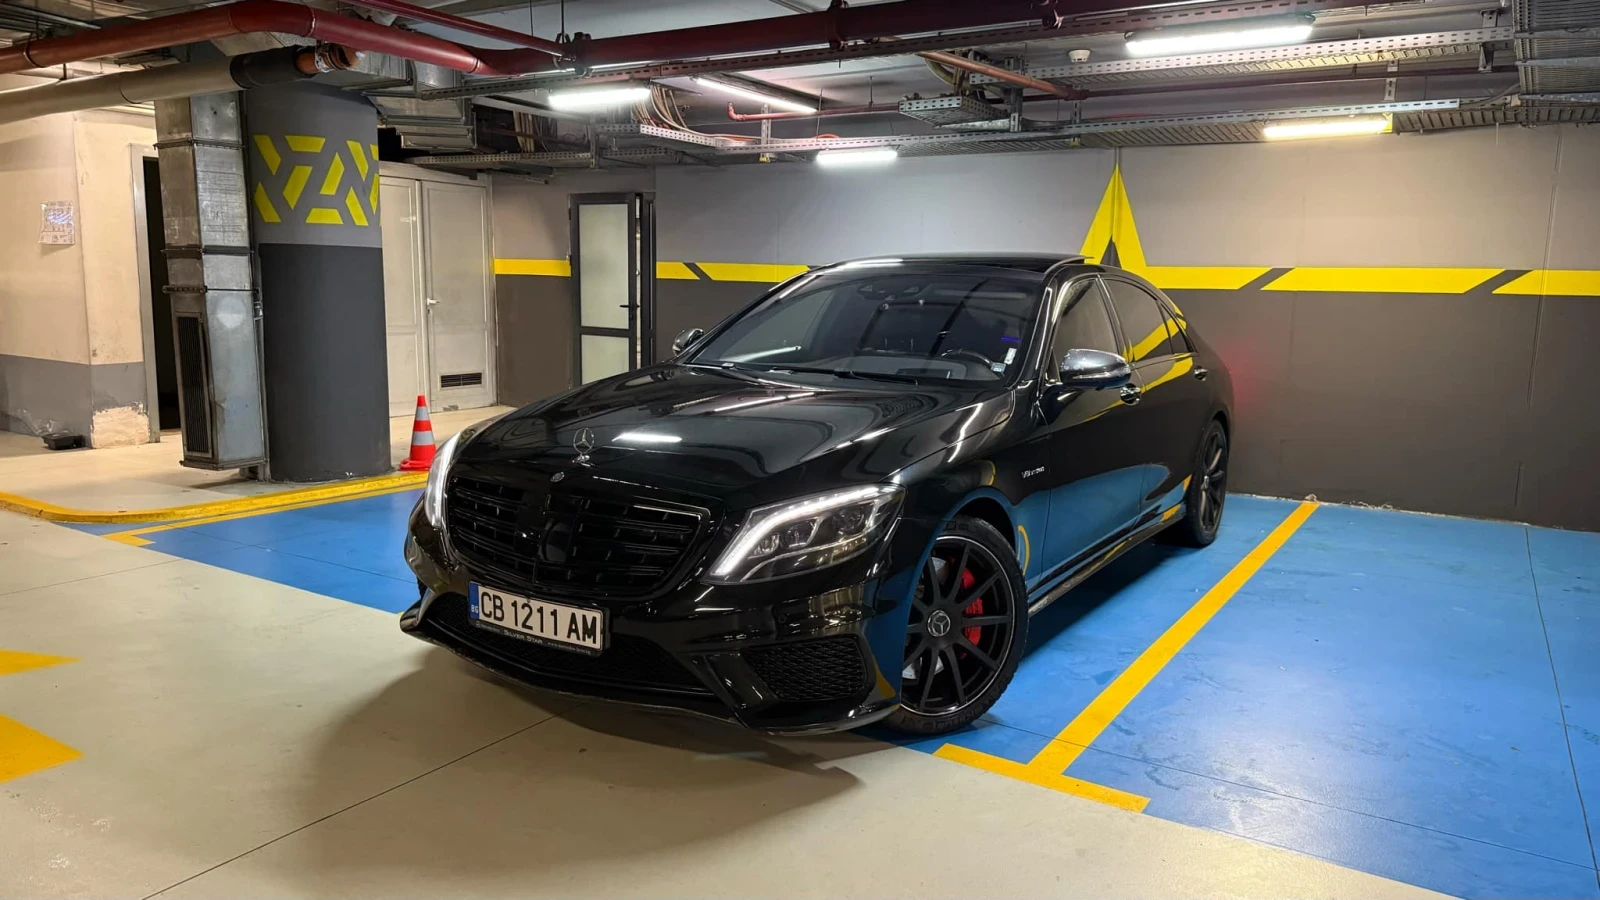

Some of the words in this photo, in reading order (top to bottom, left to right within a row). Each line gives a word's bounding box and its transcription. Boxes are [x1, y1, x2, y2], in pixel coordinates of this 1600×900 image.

[471, 604, 479, 614] BG
[481, 592, 504, 621] CB
[511, 600, 558, 636] 1211
[567, 612, 597, 644] AM
[503, 629, 525, 640] SILVER
[526, 635, 543, 645] STAR
